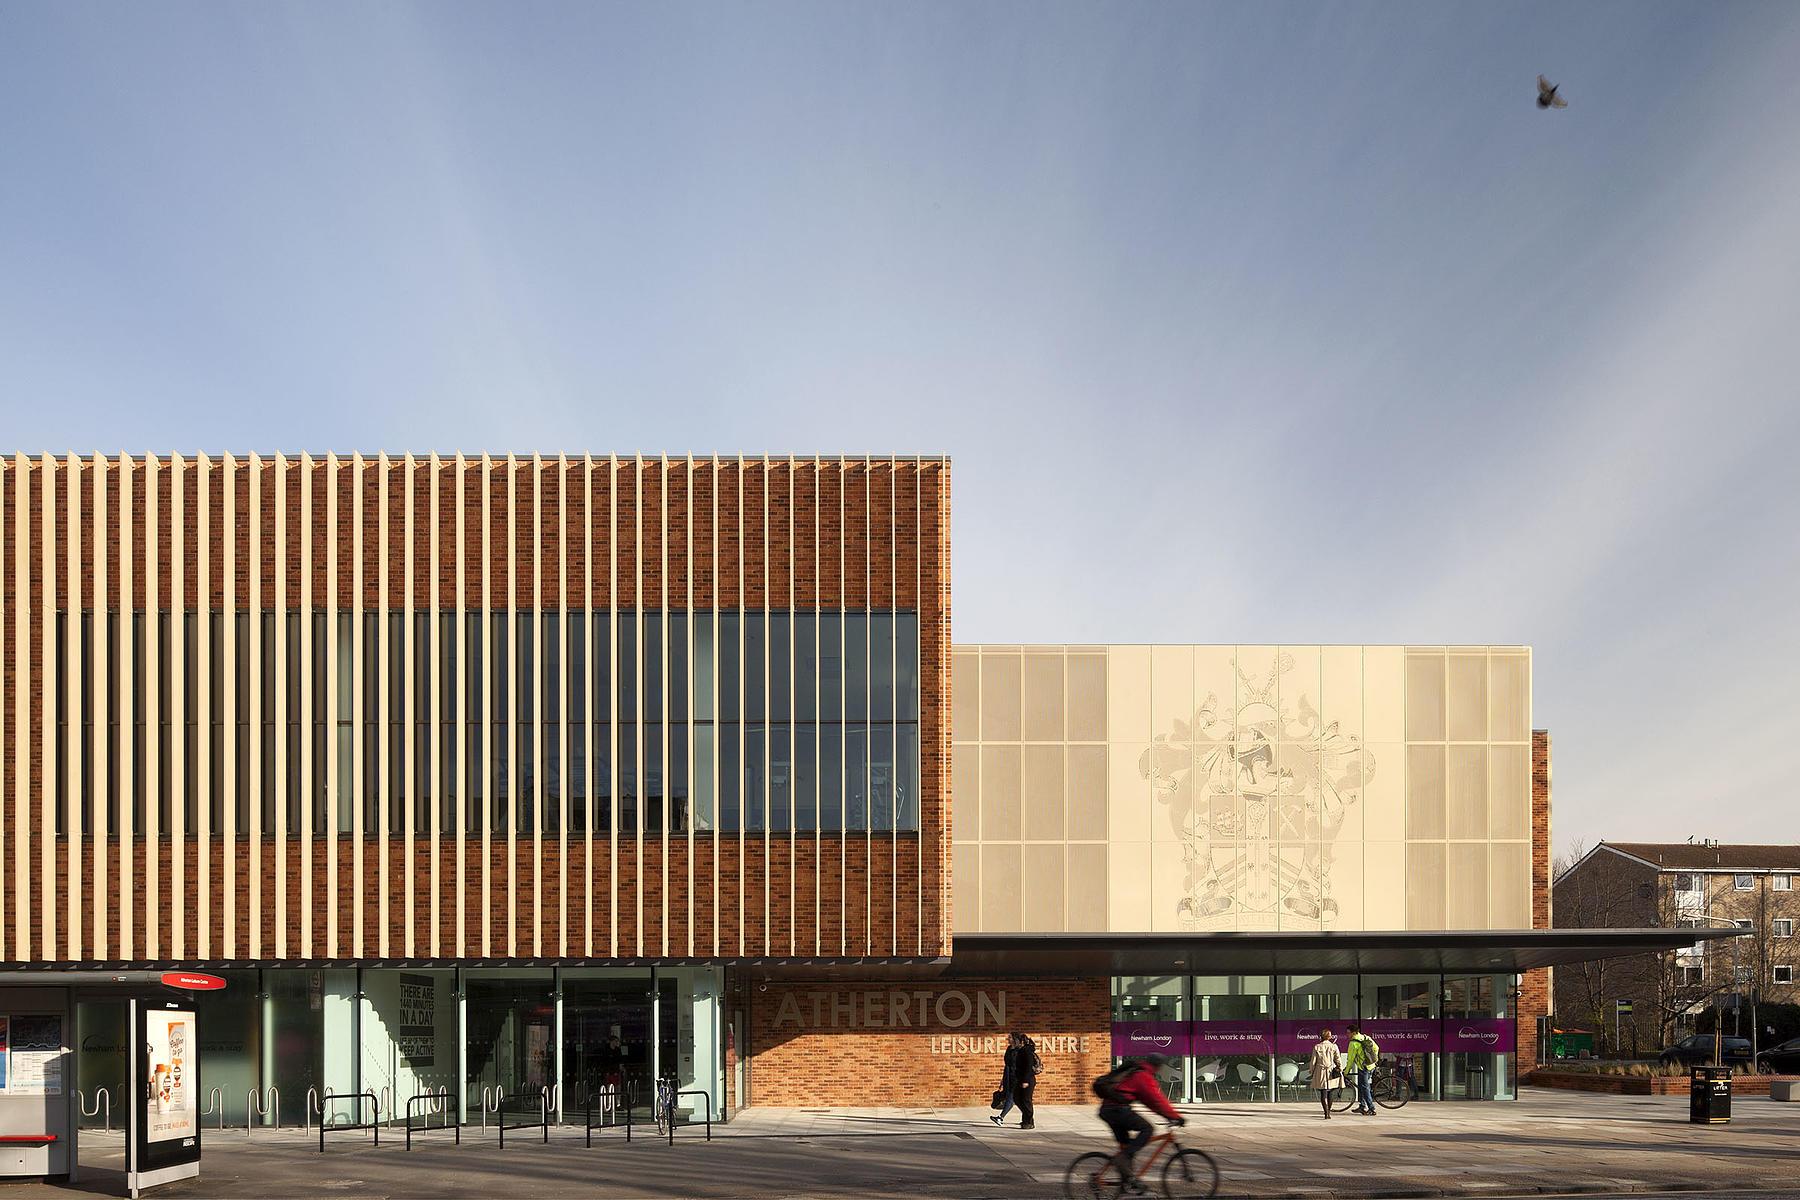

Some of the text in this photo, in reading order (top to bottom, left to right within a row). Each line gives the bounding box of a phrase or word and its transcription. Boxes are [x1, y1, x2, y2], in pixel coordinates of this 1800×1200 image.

[400, 985, 434, 1000] THERE ARE
[400, 999, 434, 1010] 1440 MINUTES
[772, 990, 1006, 1027] ATHERTON
[400, 1009, 433, 1025] IN A DAY
[1246, 1034, 1262, 1042] stay
[1413, 1032, 1429, 1040] stay
[400, 1045, 434, 1056] KEEP ACTIVE
[931, 1036, 1090, 1054] LEISURE ENTRE
